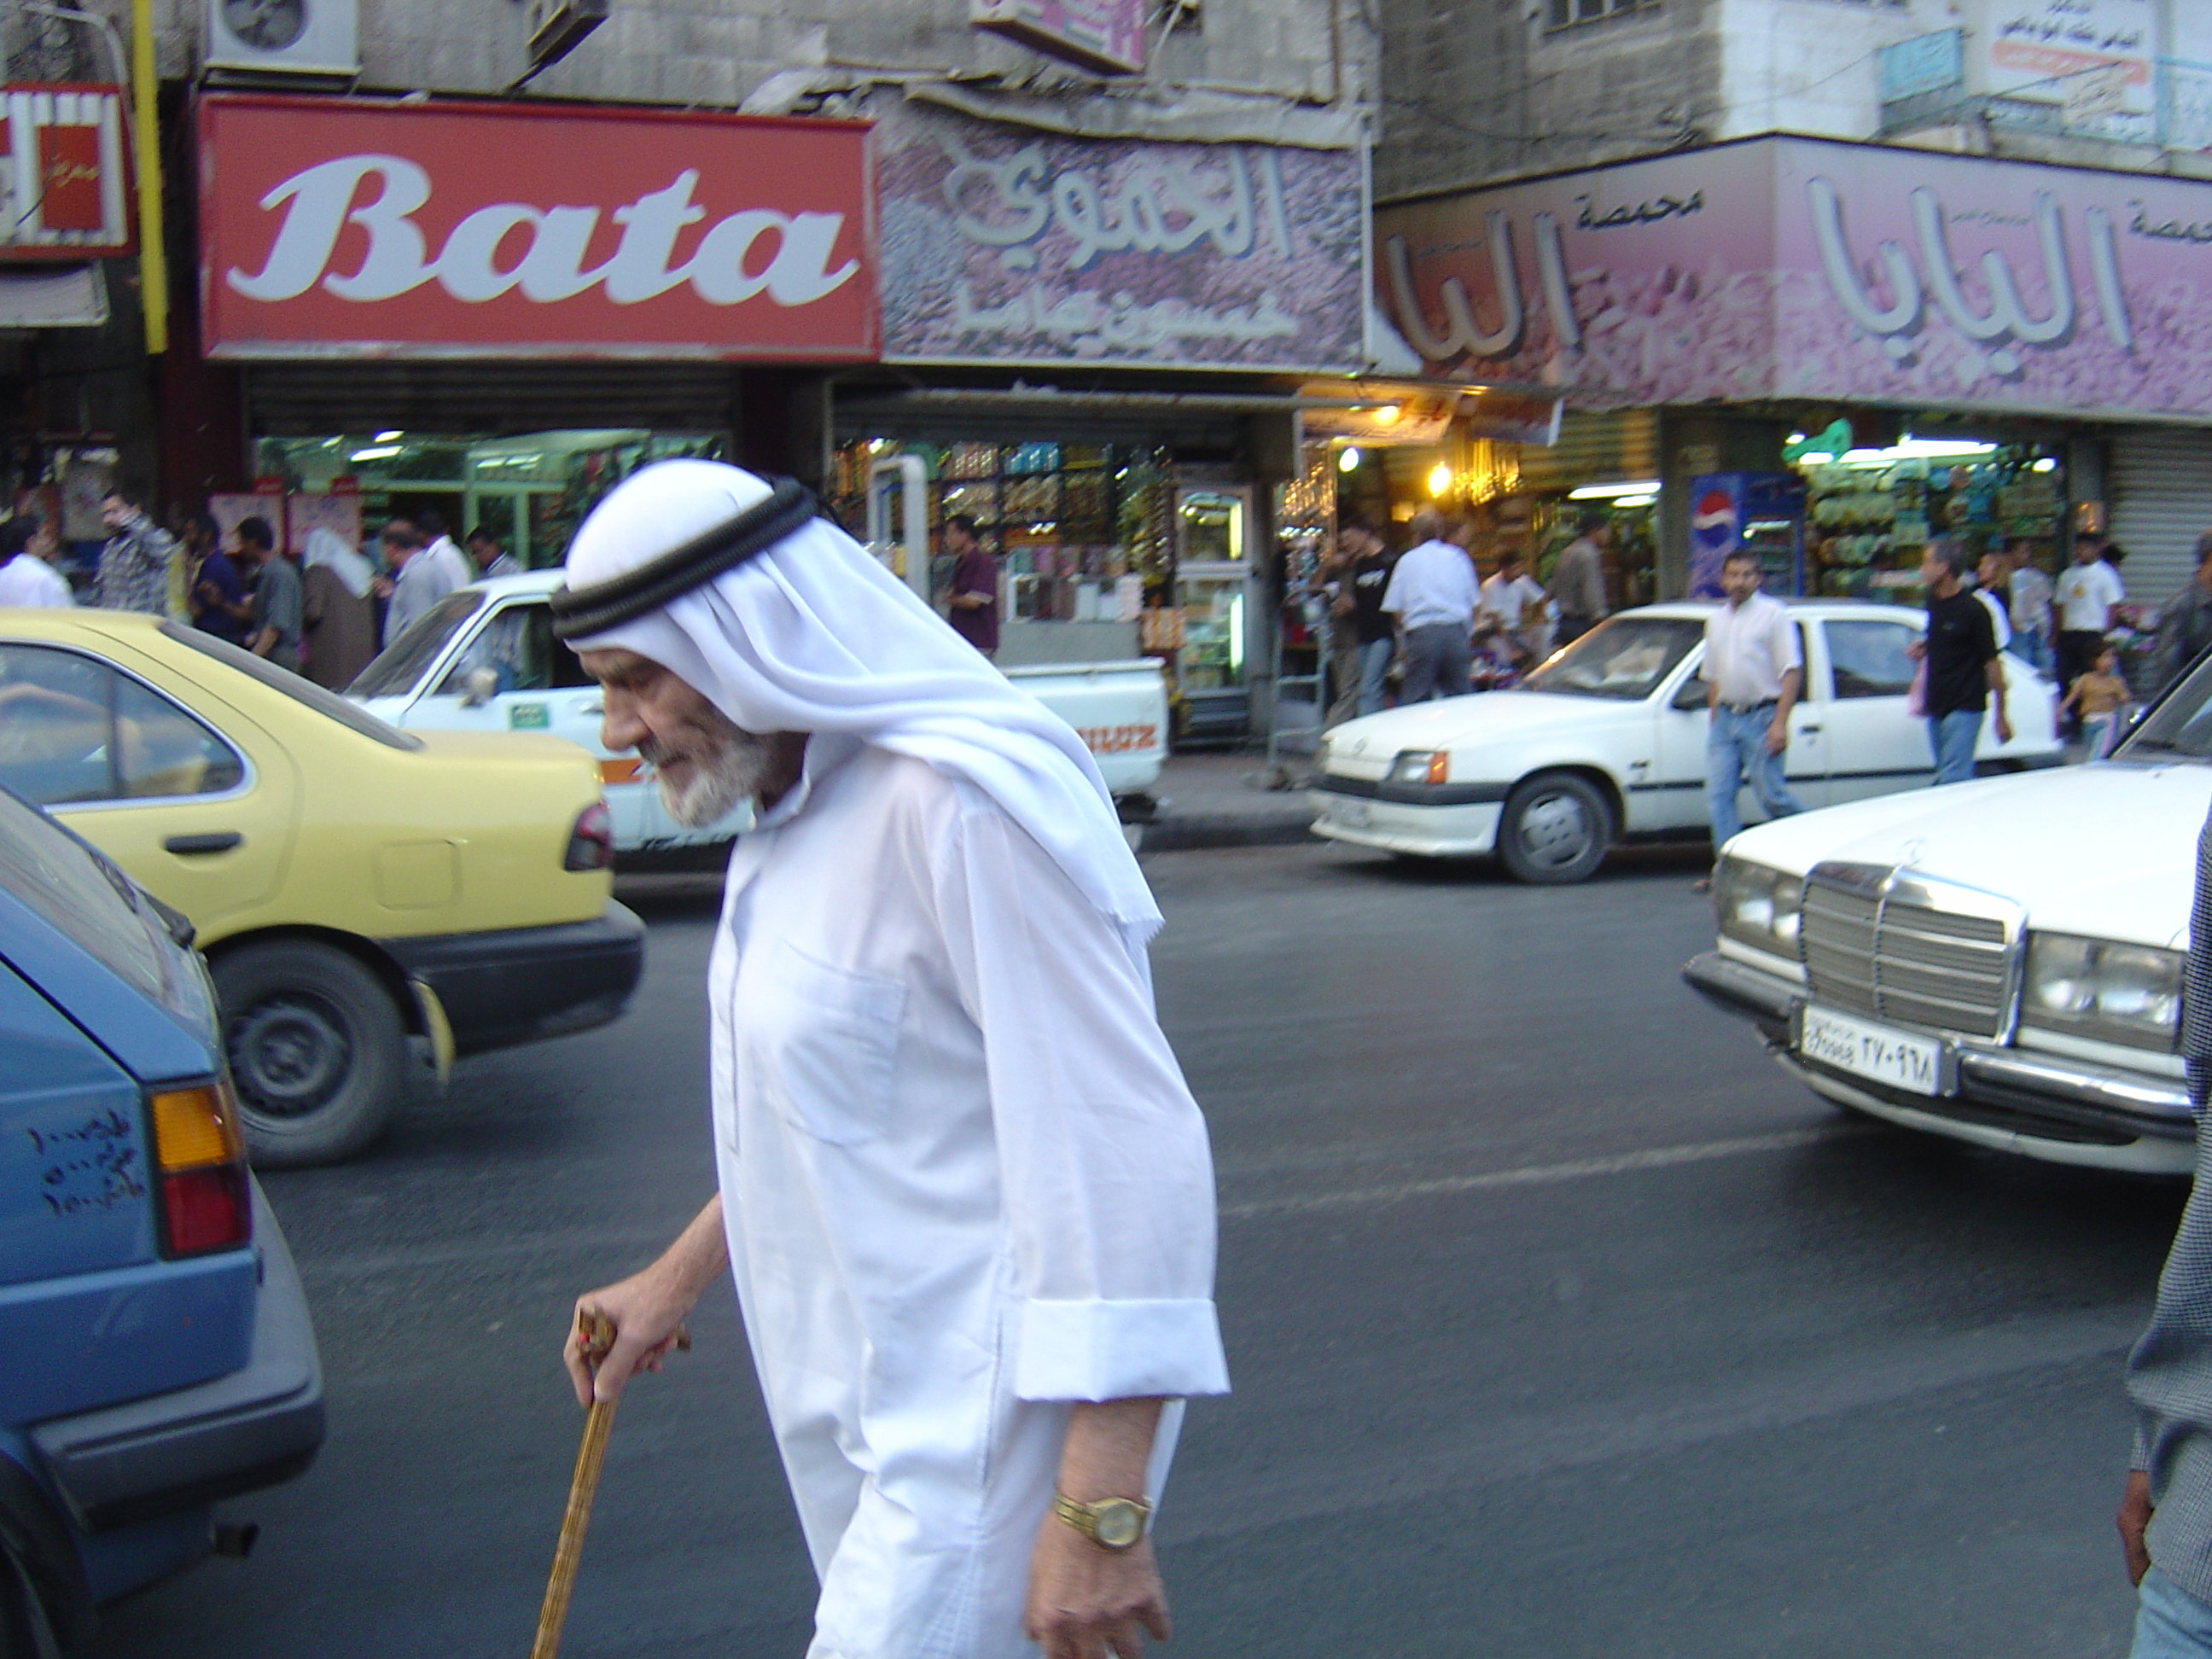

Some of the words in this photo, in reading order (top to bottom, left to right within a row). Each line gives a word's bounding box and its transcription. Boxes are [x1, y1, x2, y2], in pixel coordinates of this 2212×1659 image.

[225, 152, 860, 307] Bata
[940, 141, 1294, 271] الحموي
[1386, 211, 1584, 375] البا
